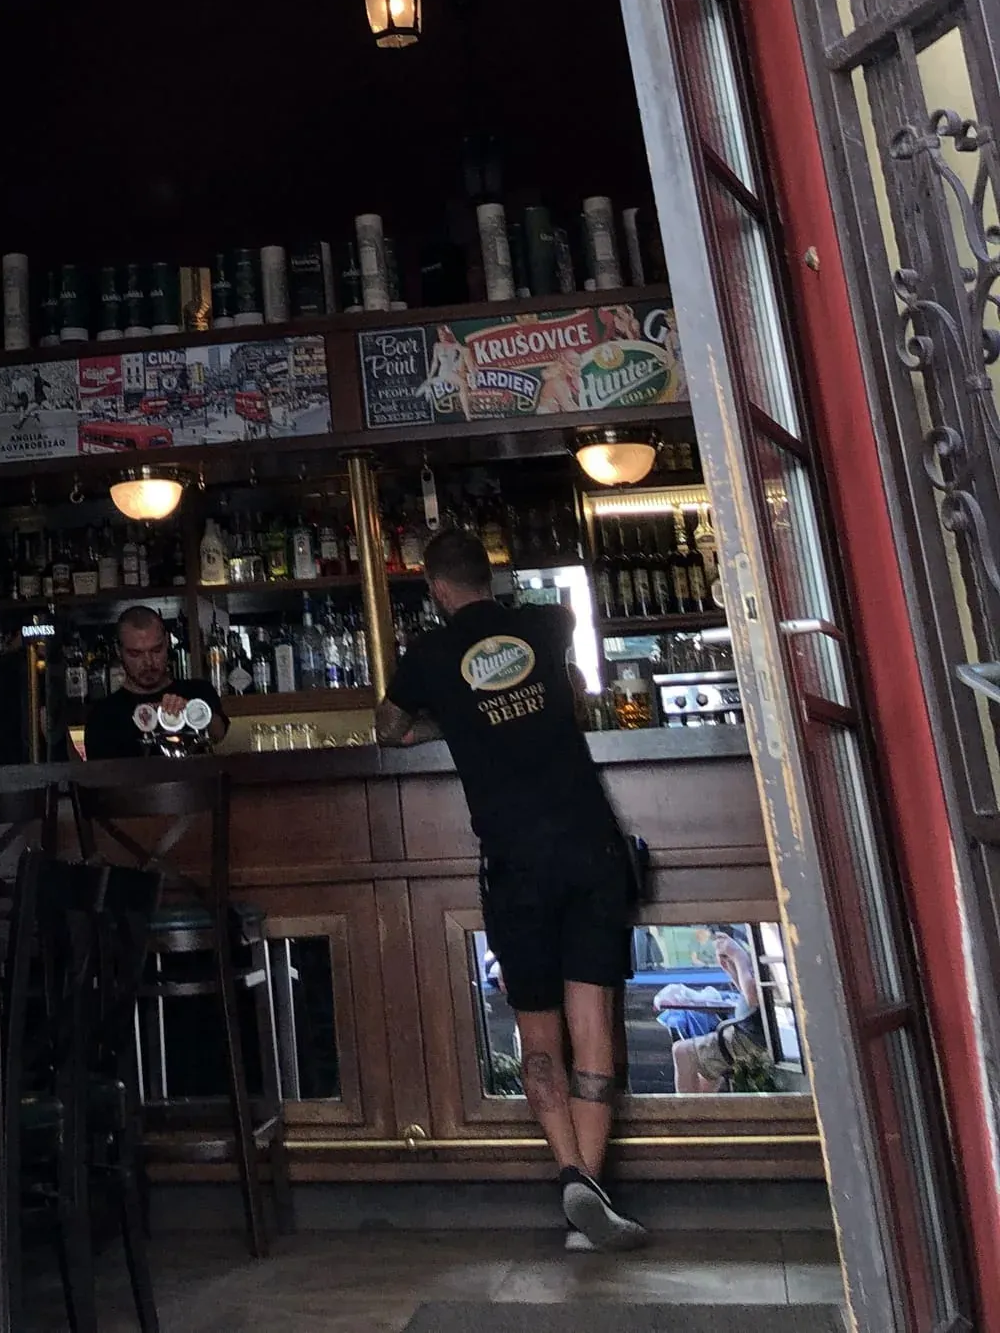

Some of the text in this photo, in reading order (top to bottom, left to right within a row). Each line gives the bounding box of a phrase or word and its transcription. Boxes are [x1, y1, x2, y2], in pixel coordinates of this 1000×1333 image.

[375, 335, 419, 357] Beer
[474, 322, 593, 365] KRUŠOVICE
[364, 354, 418, 379] Point
[21, 624, 56, 637] GUINNESS
[477, 681, 546, 713] ONE MORE
